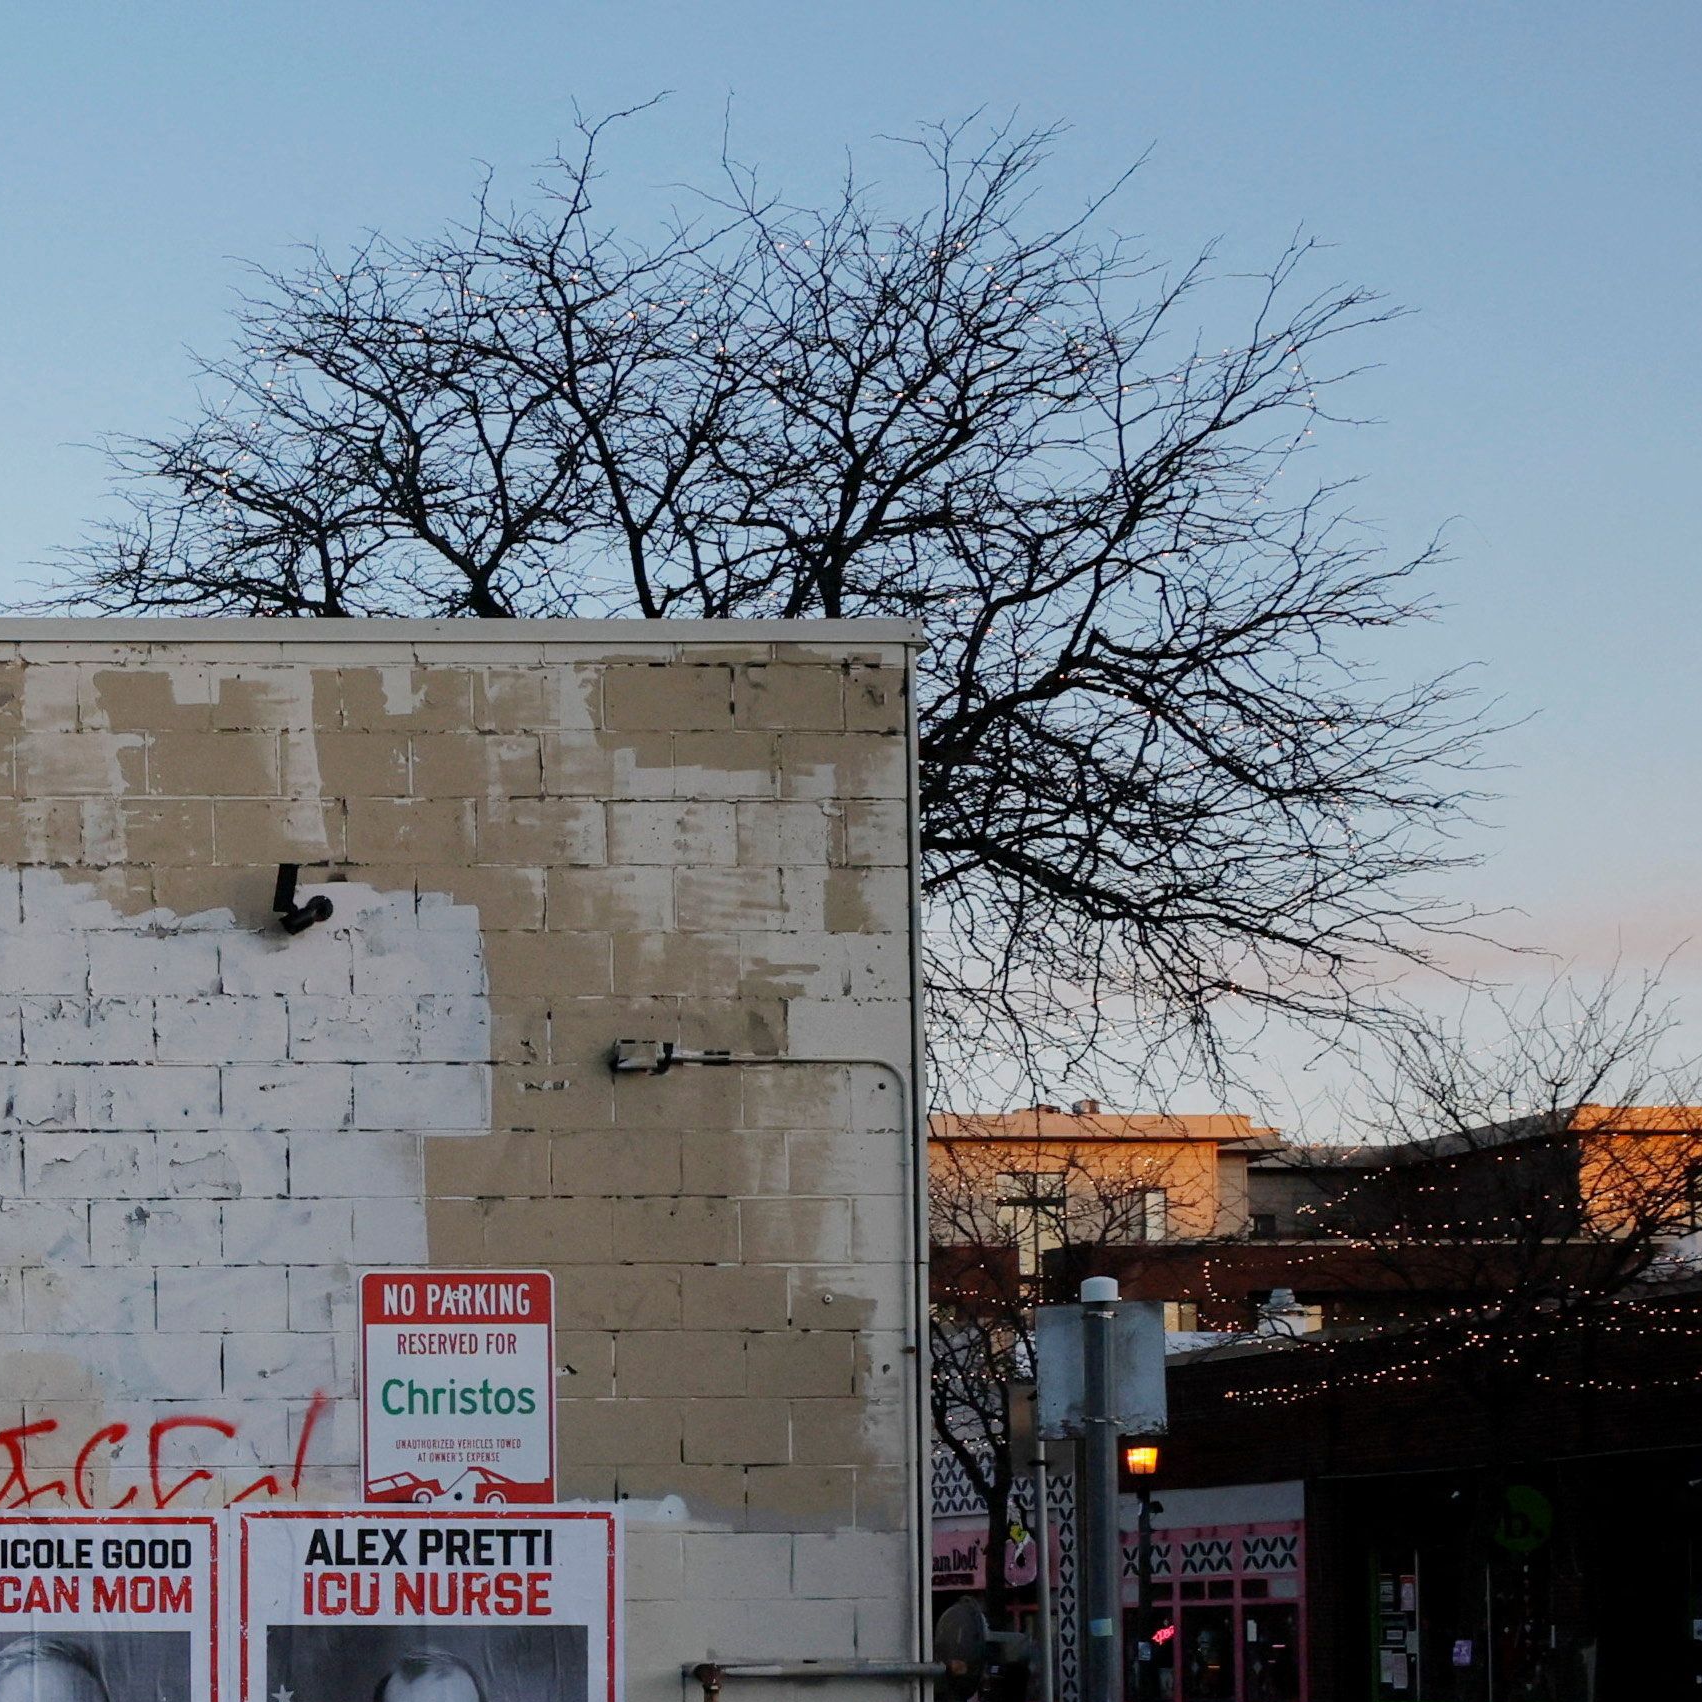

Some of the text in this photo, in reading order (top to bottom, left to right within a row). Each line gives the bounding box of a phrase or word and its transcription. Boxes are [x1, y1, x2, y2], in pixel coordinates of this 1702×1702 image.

[383, 1284, 530, 1316] NO PARKING
[397, 1334, 517, 1354] RESERVED FOR
[382, 1379, 536, 1415] Christos
[396, 1439, 521, 1449] UNAUTHORIZED VEHICLES TOWED
[418, 1453, 426, 1462] AT
[467, 1453, 500, 1462] EXPENSE
[103, 1539, 191, 1569] GOOD
[305, 1529, 552, 1565] ALEX PRETTI
[953, 1546, 977, 1570] Doll
[94, 1576, 192, 1613] MOM
[304, 1572, 552, 1615] ICU NURSE
